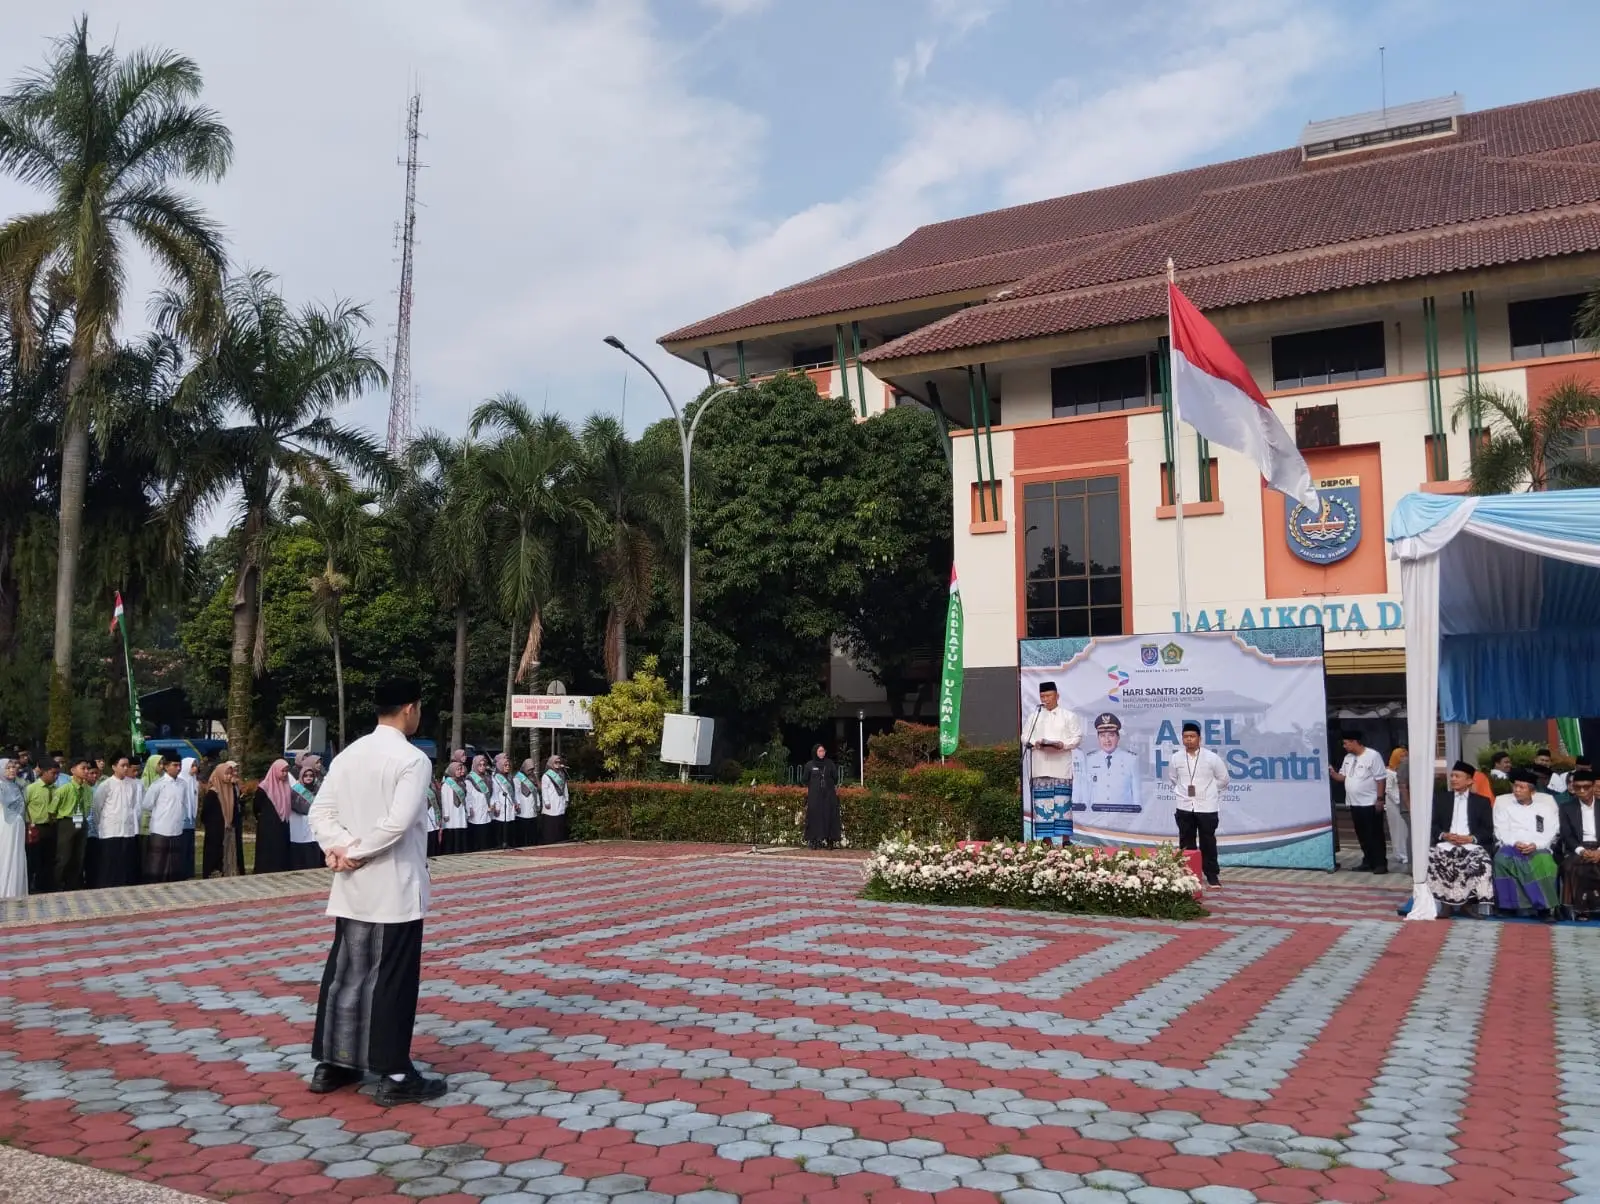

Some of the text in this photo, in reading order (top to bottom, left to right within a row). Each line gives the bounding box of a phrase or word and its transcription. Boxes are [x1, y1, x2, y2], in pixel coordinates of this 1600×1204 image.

[1320, 478, 1352, 488] DEPOK
[941, 679, 955, 723] ULAMA
[1122, 686, 1204, 696] HARI SANTRI 2025
[1226, 748, 1321, 780] Santri
